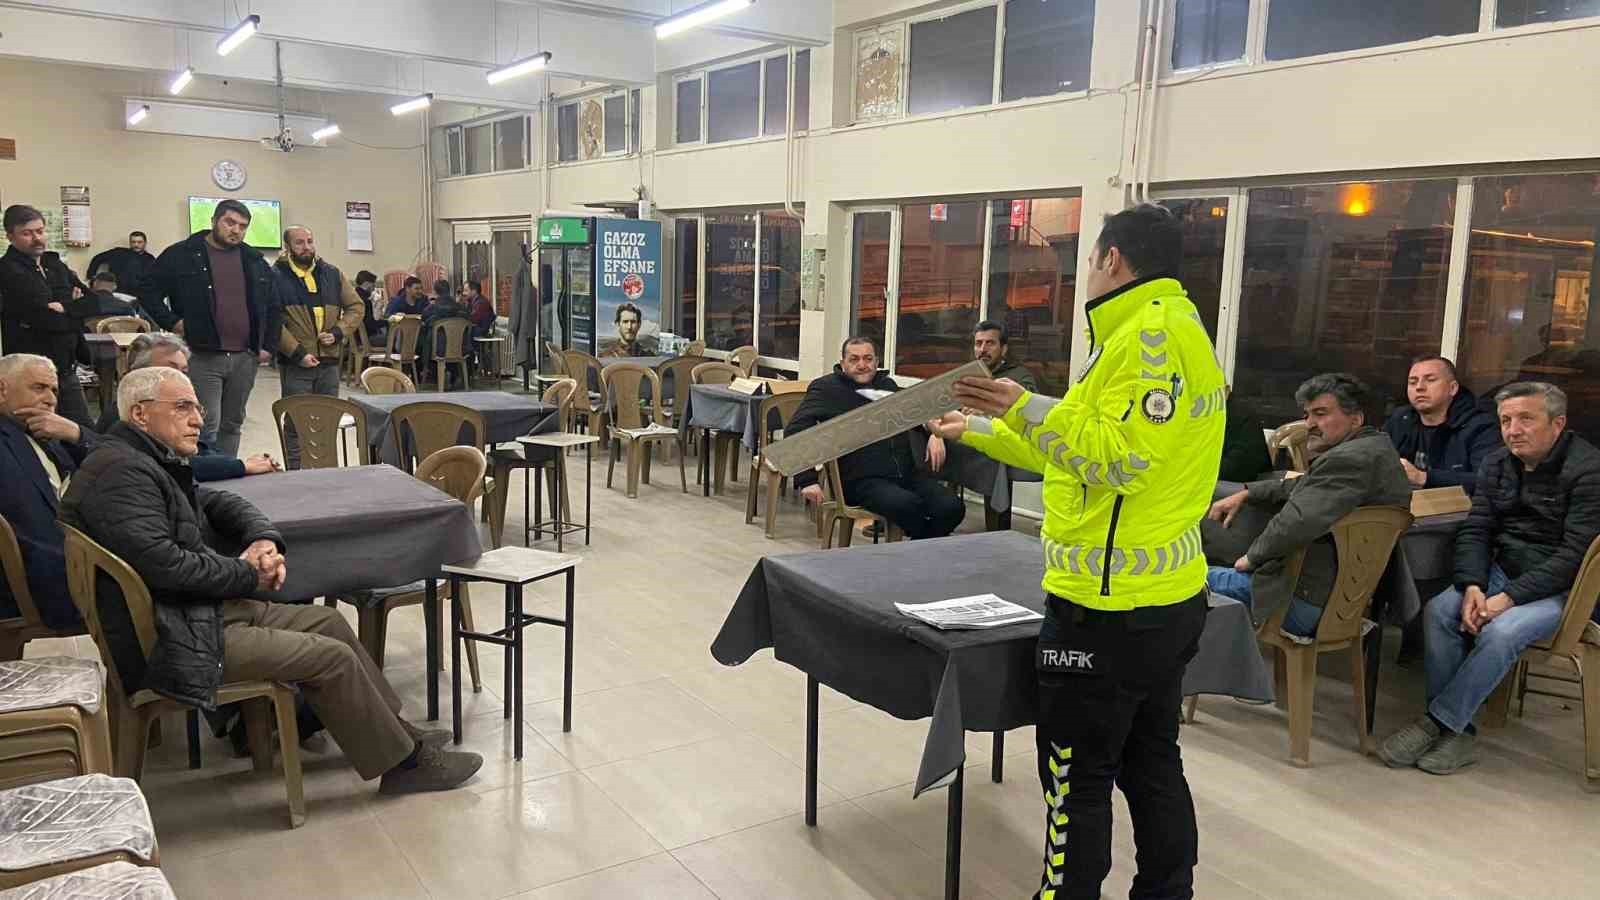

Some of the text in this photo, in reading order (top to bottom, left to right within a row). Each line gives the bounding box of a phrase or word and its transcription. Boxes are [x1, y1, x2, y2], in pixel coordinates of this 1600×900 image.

[604, 231, 646, 245] GAZOZ
[604, 245, 641, 259] OLMA
[604, 259, 655, 274] EFSANE
[604, 273, 621, 287] OL
